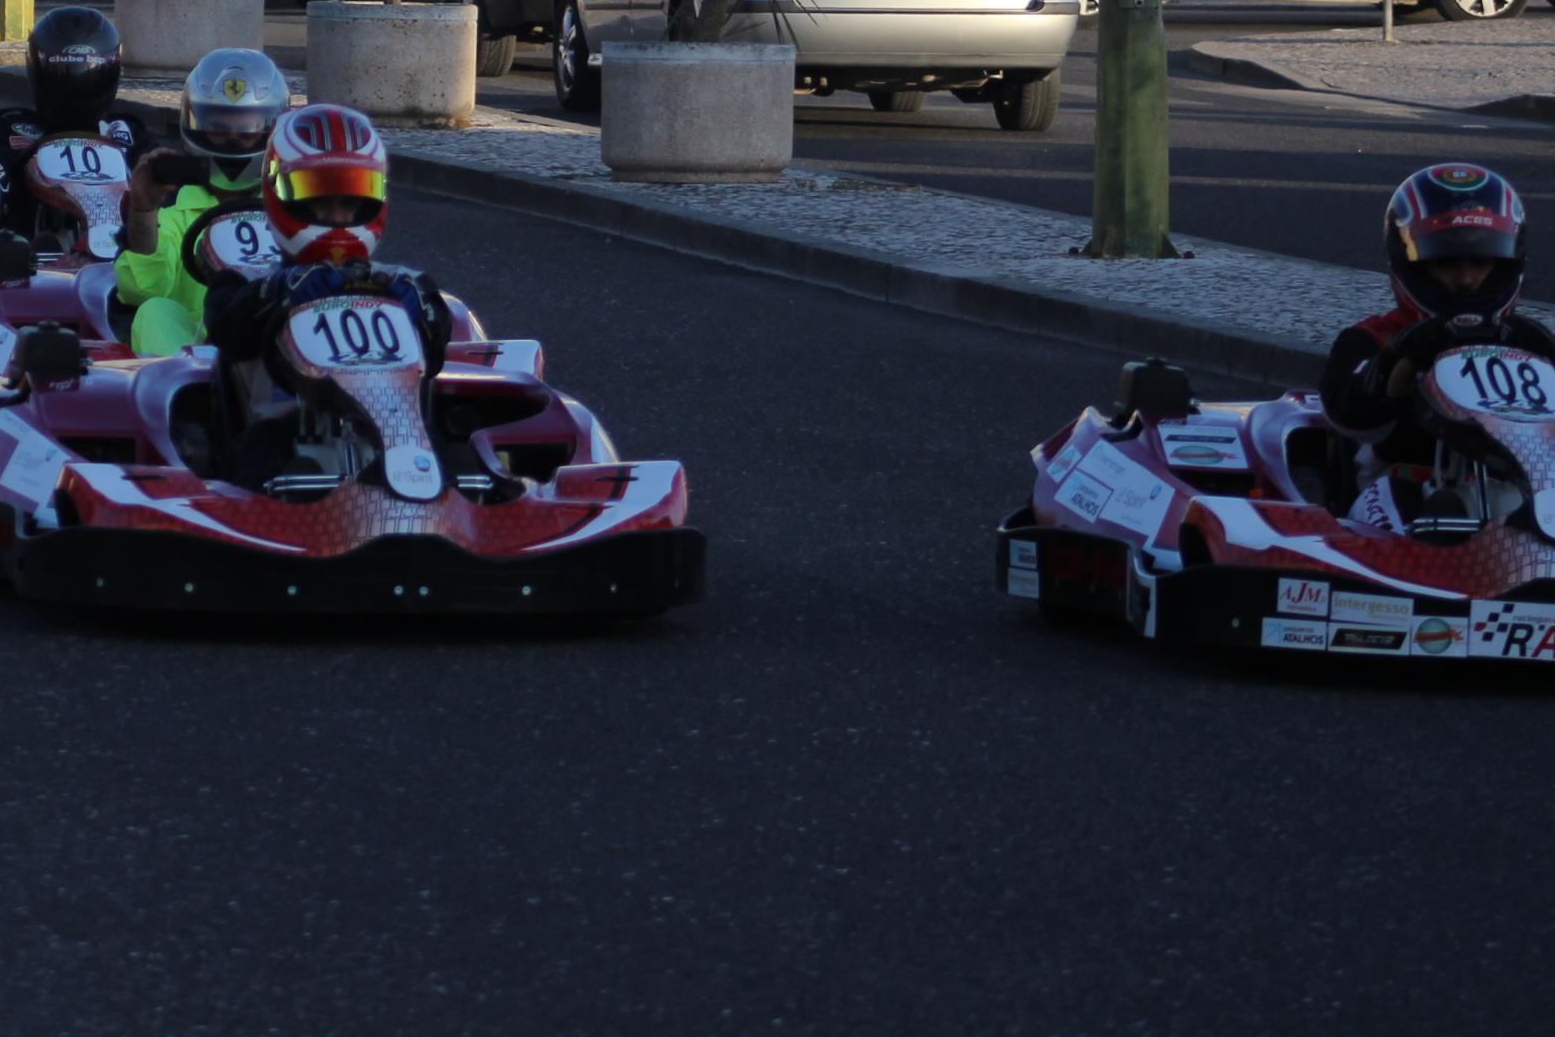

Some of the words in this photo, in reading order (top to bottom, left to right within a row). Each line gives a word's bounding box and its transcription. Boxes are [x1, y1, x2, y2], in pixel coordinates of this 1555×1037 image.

[48, 54, 84, 62] clube
[59, 145, 101, 173] 10
[313, 309, 400, 357] 100
[1459, 356, 1548, 405] 108
[1283, 633, 1324, 645] ATALHOS
